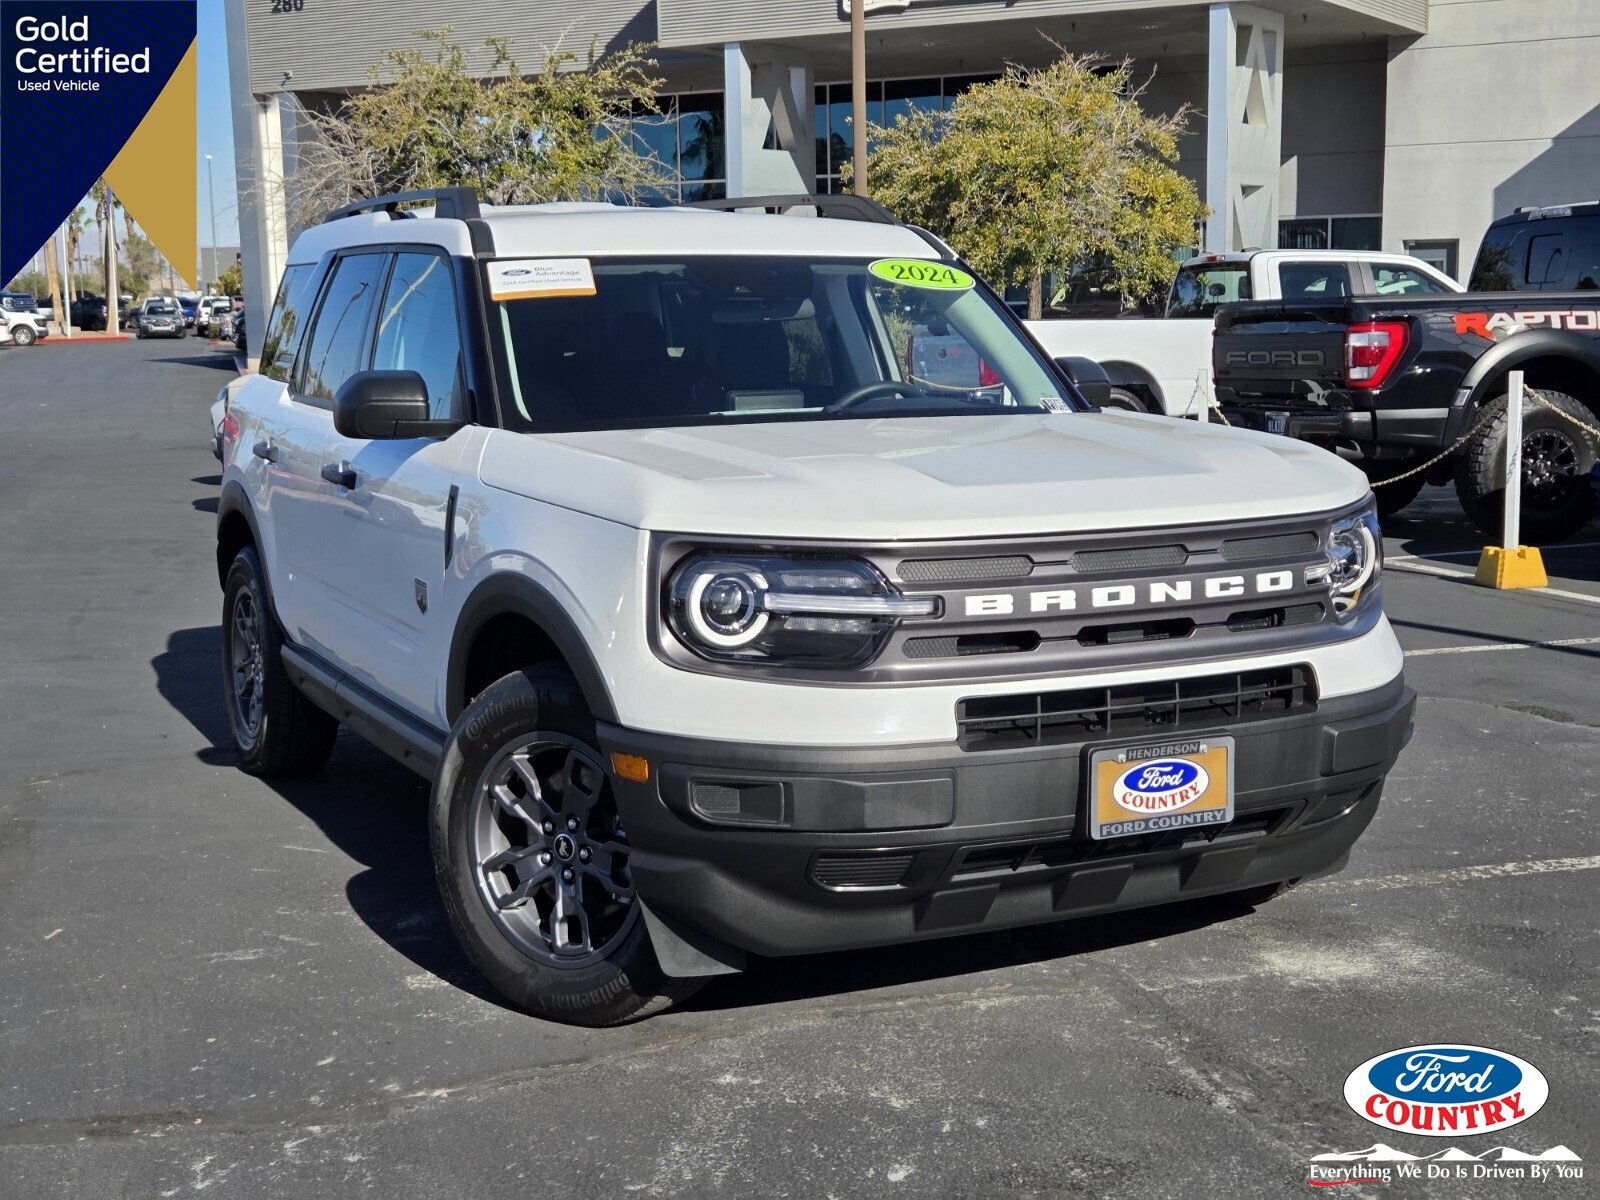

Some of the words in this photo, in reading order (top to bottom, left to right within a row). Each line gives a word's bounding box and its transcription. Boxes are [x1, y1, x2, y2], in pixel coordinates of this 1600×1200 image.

[890, 265, 959, 284] 2024
[1453, 310, 1600, 341] RAPTO
[1226, 350, 1325, 366] FORD
[964, 570, 1293, 616] BRONCO
[1128, 743, 1199, 760] HENDERSON
[1138, 766, 1184, 789] Ford
[1122, 781, 1200, 809] COUNTRY
[1102, 821, 1145, 836] FORD
[1149, 810, 1225, 829] COUNTRY
[551, 968, 632, 1010] ontinental
